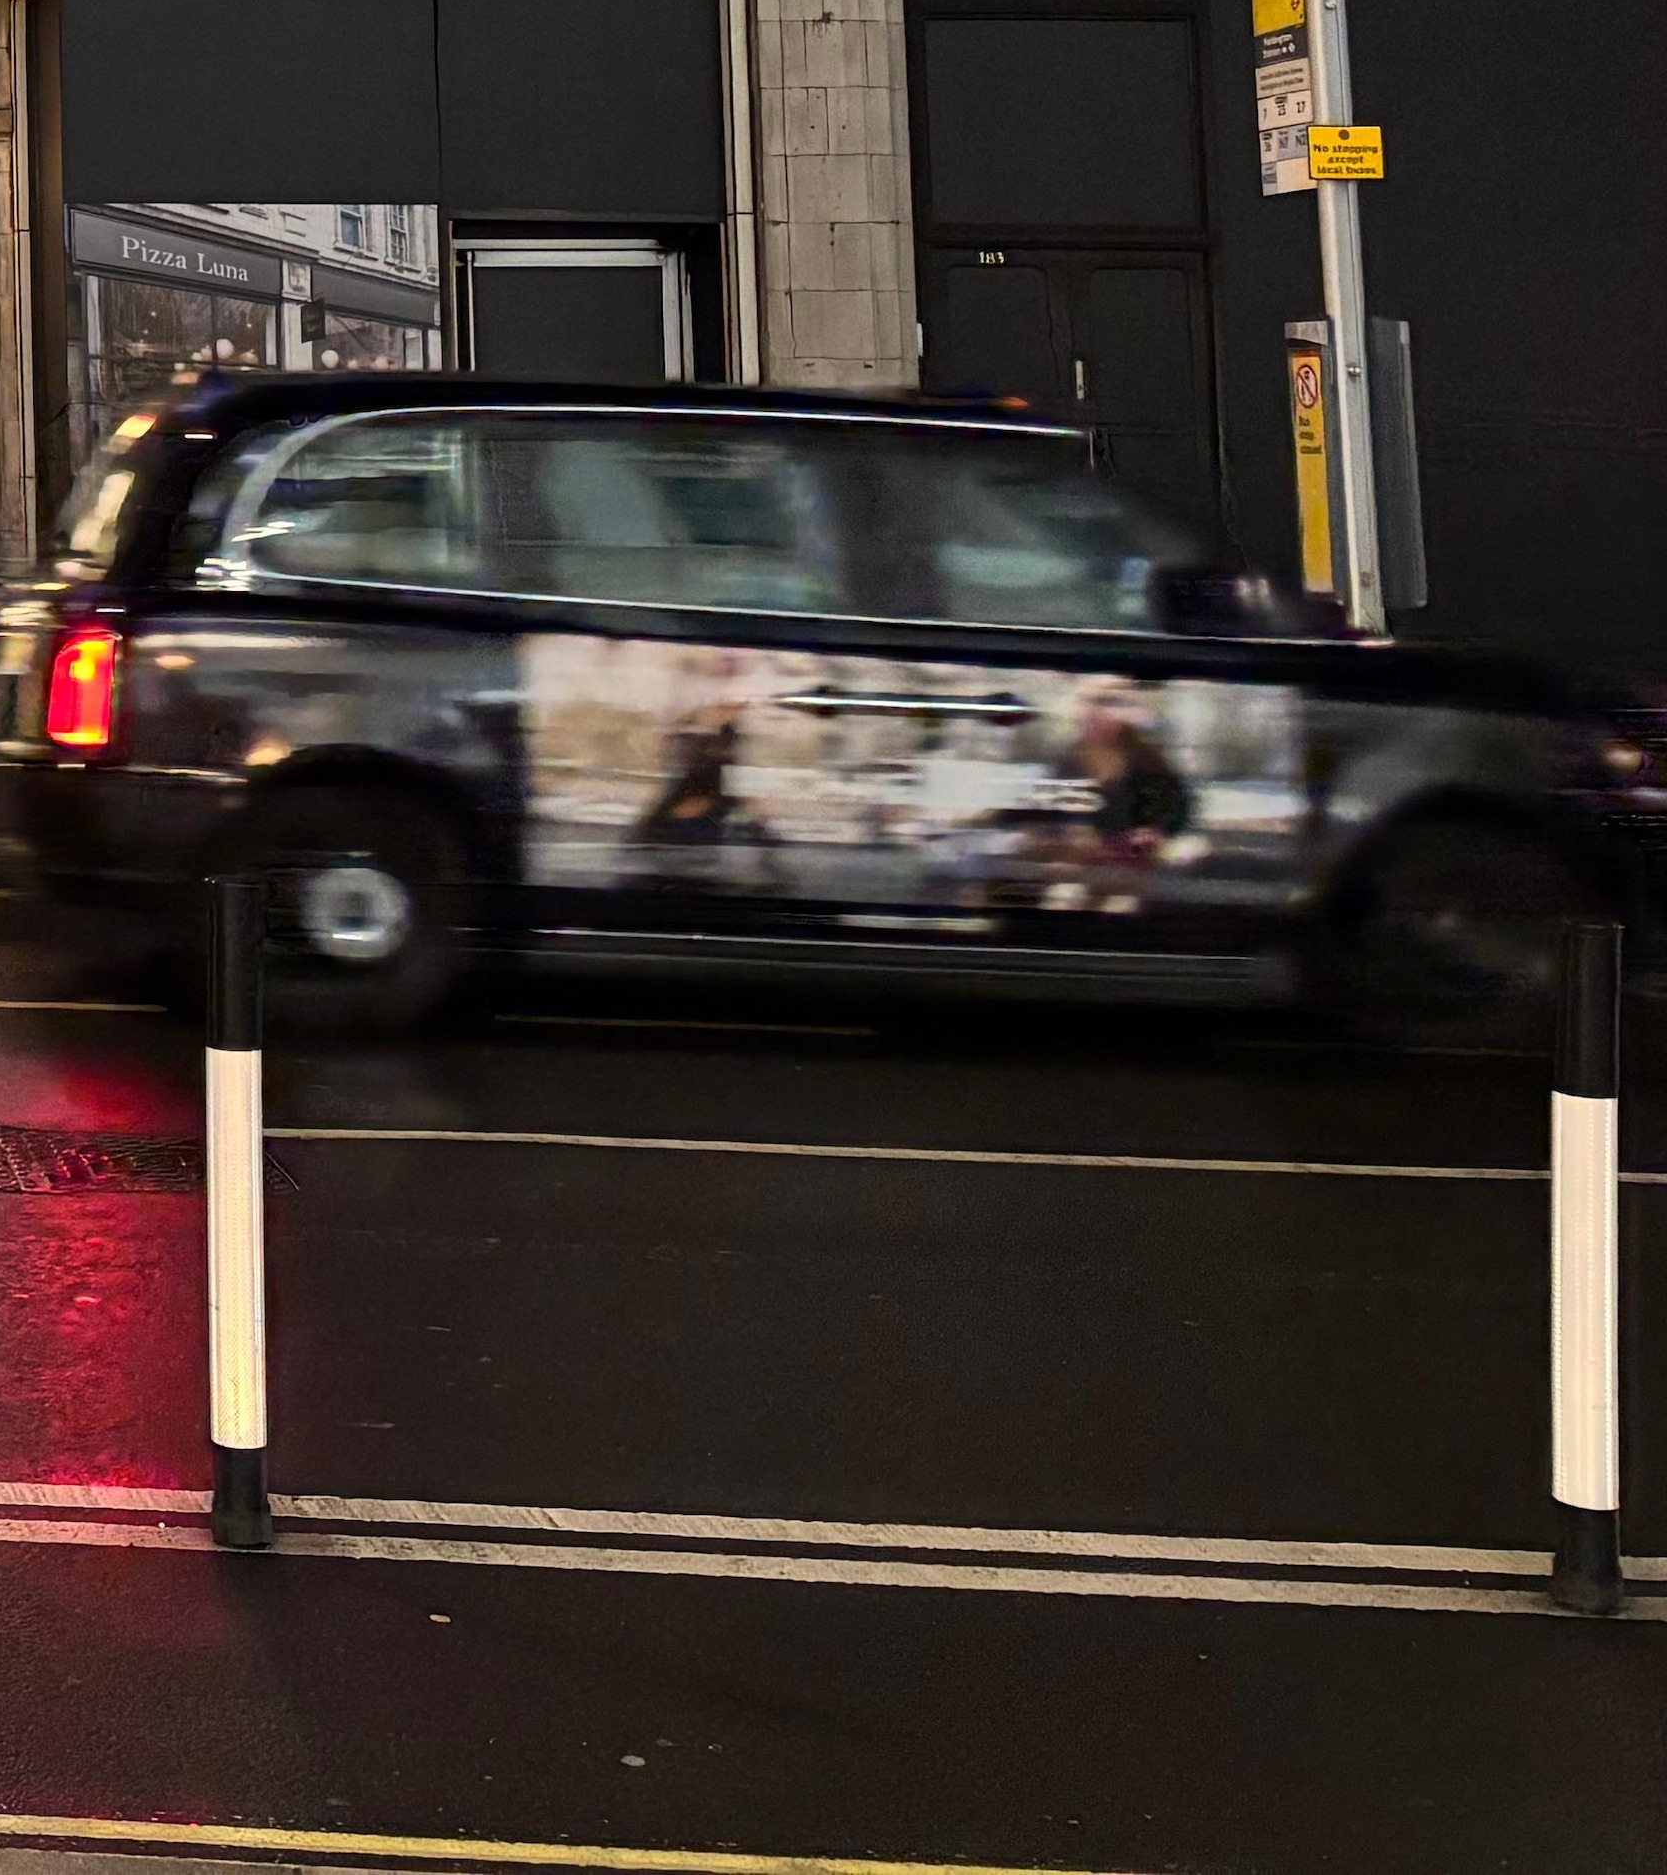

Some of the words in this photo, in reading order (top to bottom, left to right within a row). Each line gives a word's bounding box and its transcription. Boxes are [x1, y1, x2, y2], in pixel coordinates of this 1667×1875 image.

[1313, 144, 1329, 153] No
[1332, 144, 1378, 154] stopping
[1328, 155, 1364, 165] except
[121, 235, 188, 270] Pizza
[196, 252, 249, 282] Luna
